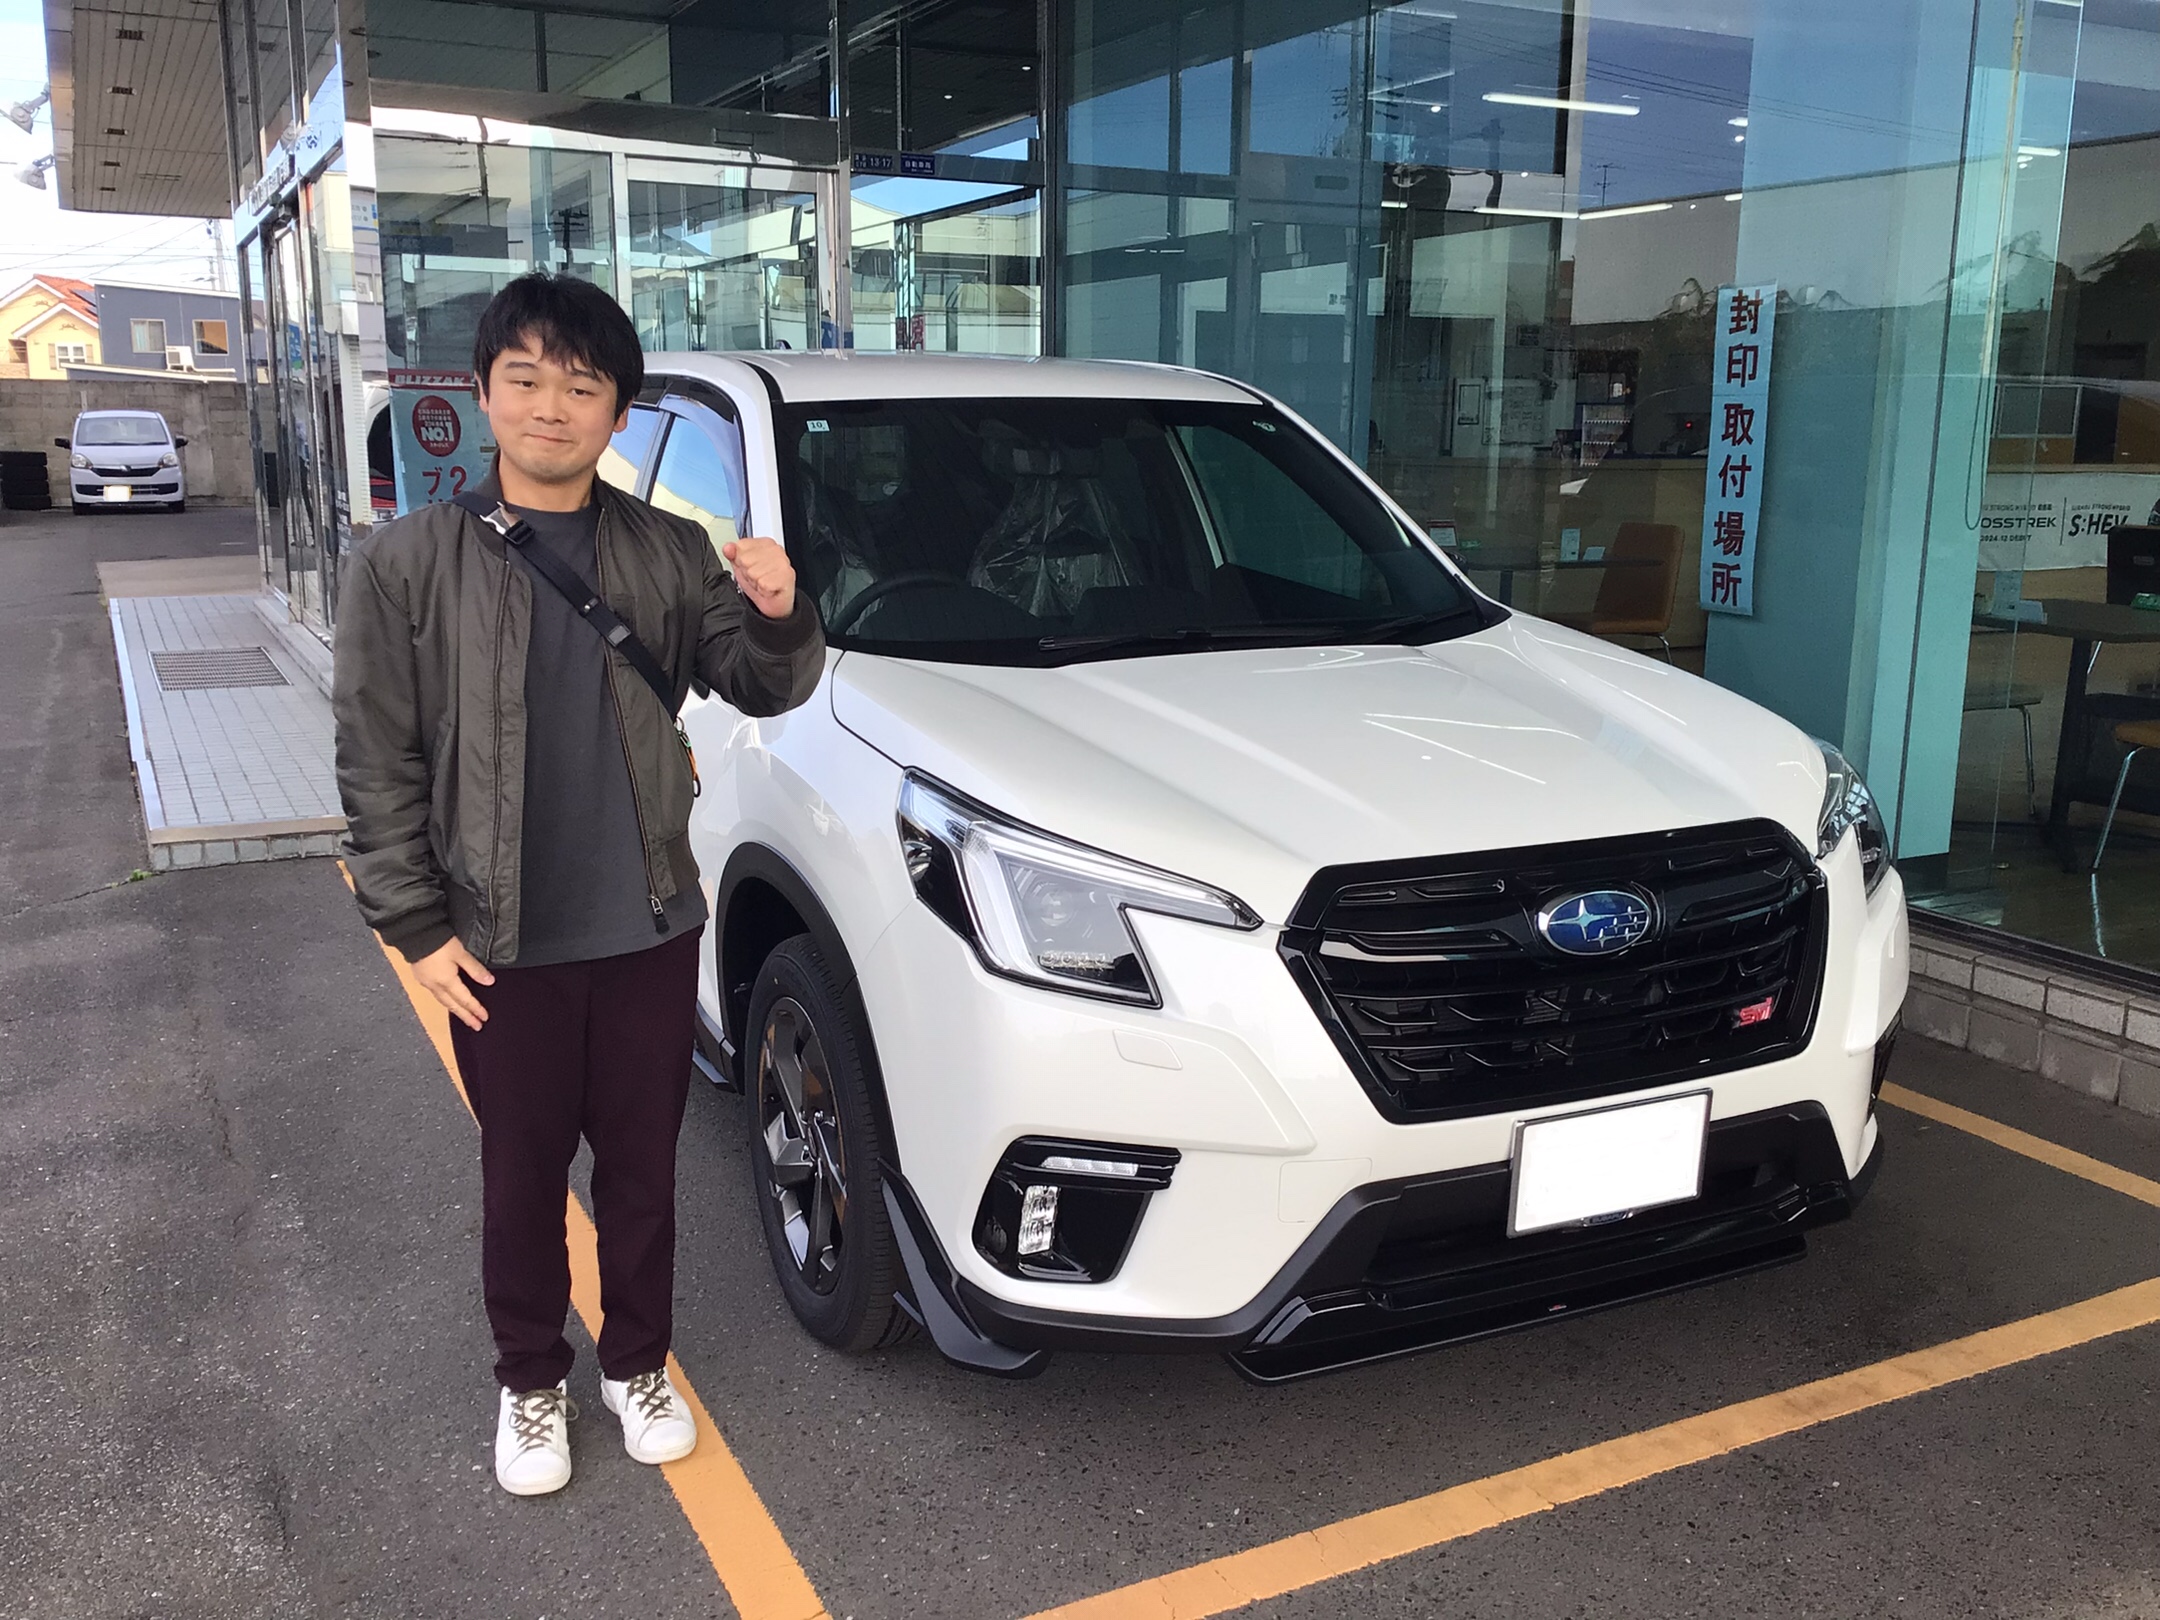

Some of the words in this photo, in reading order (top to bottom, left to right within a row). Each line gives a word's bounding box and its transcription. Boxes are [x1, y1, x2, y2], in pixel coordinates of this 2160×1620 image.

[394, 374, 464, 386] BLIZZAK
[420, 421, 455, 442] NO.1
[1710, 289, 1764, 607] 封印取付場所
